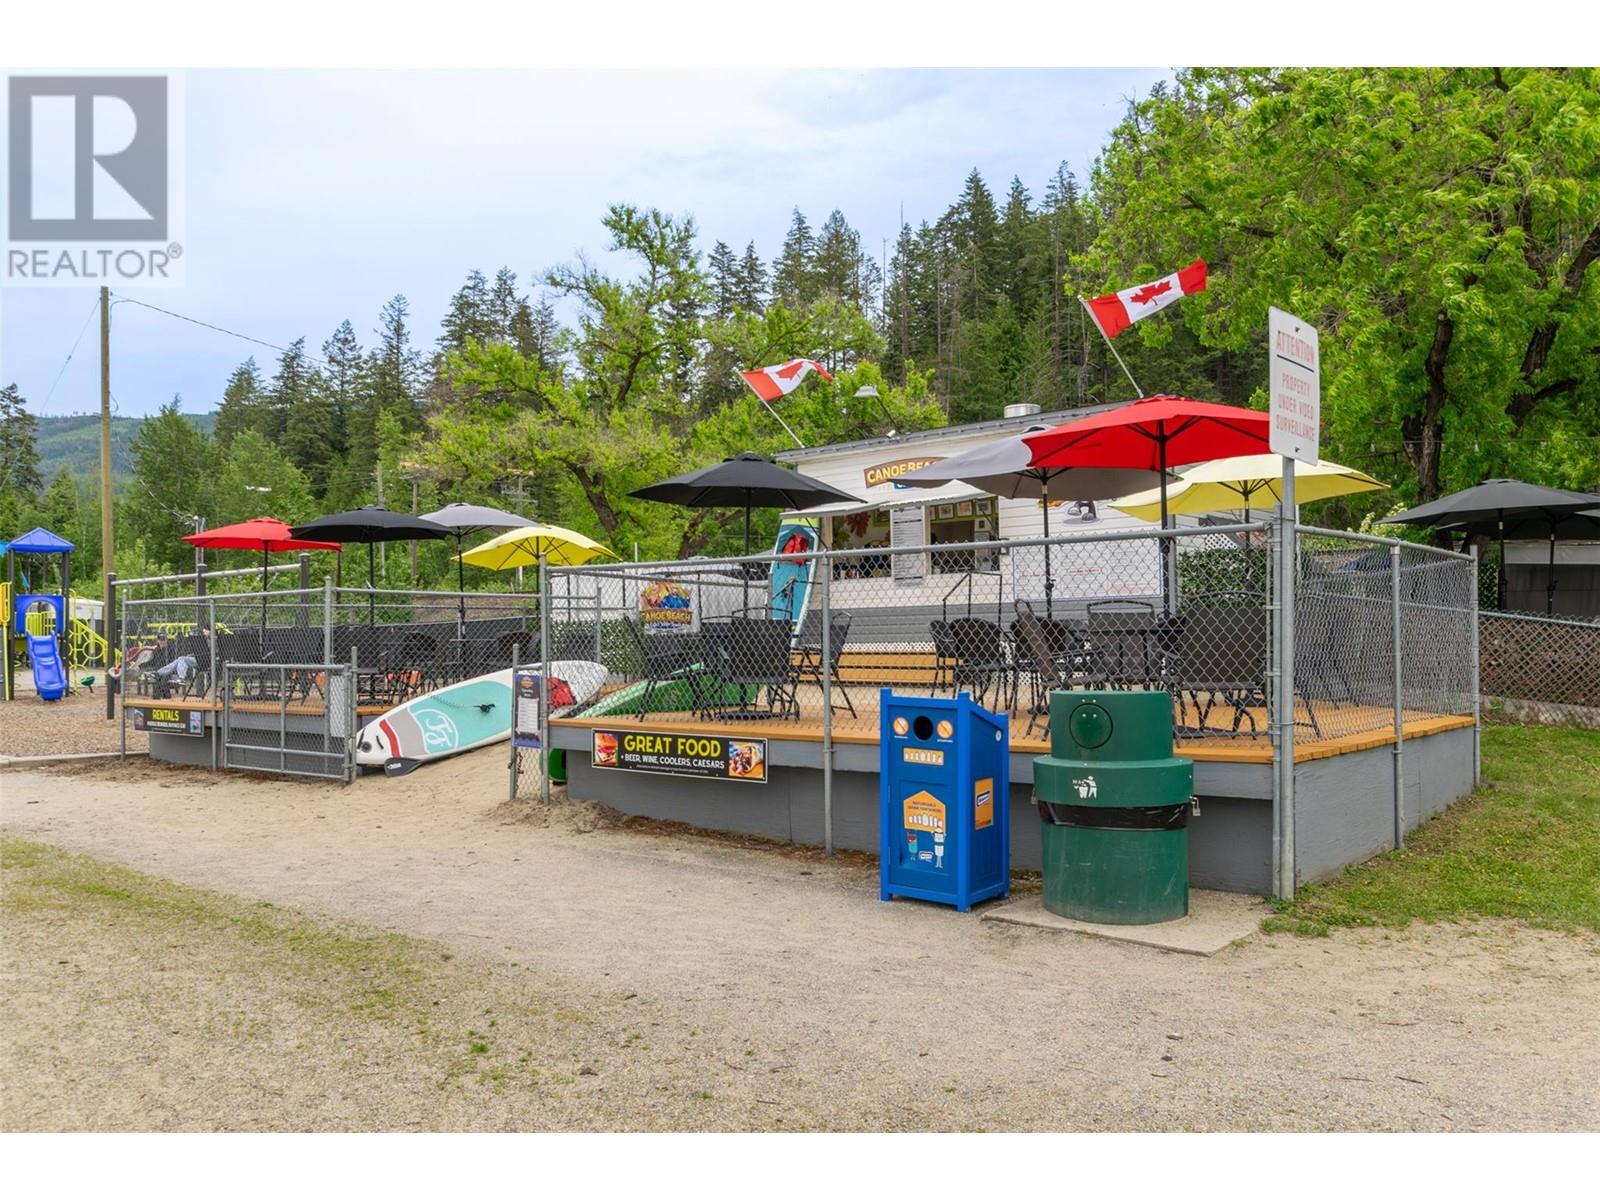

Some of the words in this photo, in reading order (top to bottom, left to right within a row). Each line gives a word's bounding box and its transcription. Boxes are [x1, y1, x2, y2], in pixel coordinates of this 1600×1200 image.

[1276, 332, 1314, 365] ATTENTION
[1282, 372, 1311, 395] PROPERTY
[1278, 393, 1297, 413] UNDER
[1299, 402, 1314, 420] VIDEO
[1276, 414, 1316, 442] SURVEILLANCE
[152, 709, 180, 721] RENTALS
[624, 735, 672, 754] GREAT
[678, 738, 721, 757] FOOD
[659, 756, 693, 767] COOLERS,
[692, 758, 725, 769] CAESARS
